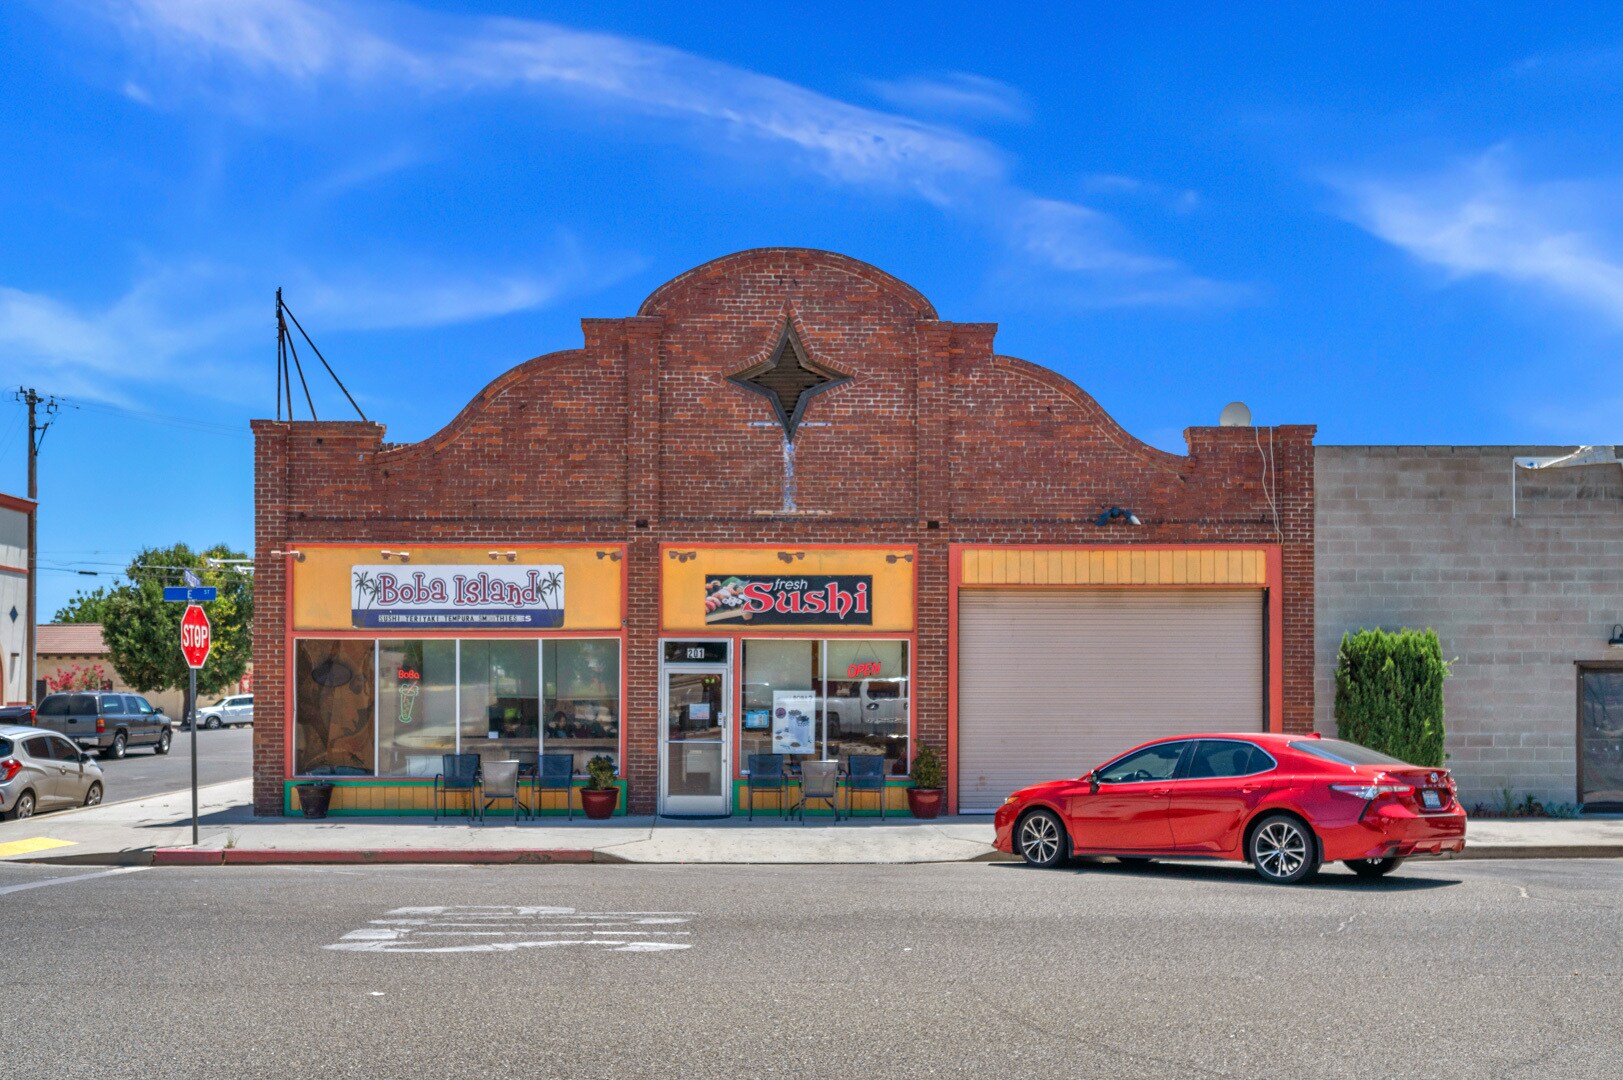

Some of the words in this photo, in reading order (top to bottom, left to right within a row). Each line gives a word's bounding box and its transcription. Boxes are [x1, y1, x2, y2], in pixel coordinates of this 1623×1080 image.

[377, 572, 448, 606] Boba
[453, 570, 539, 608] Island
[773, 578, 808, 591] fresh
[187, 589, 192, 599] E
[742, 582, 869, 620] Sushi
[183, 624, 208, 648] STOP
[688, 649, 705, 659] 201
[847, 661, 881, 679] OPEN
